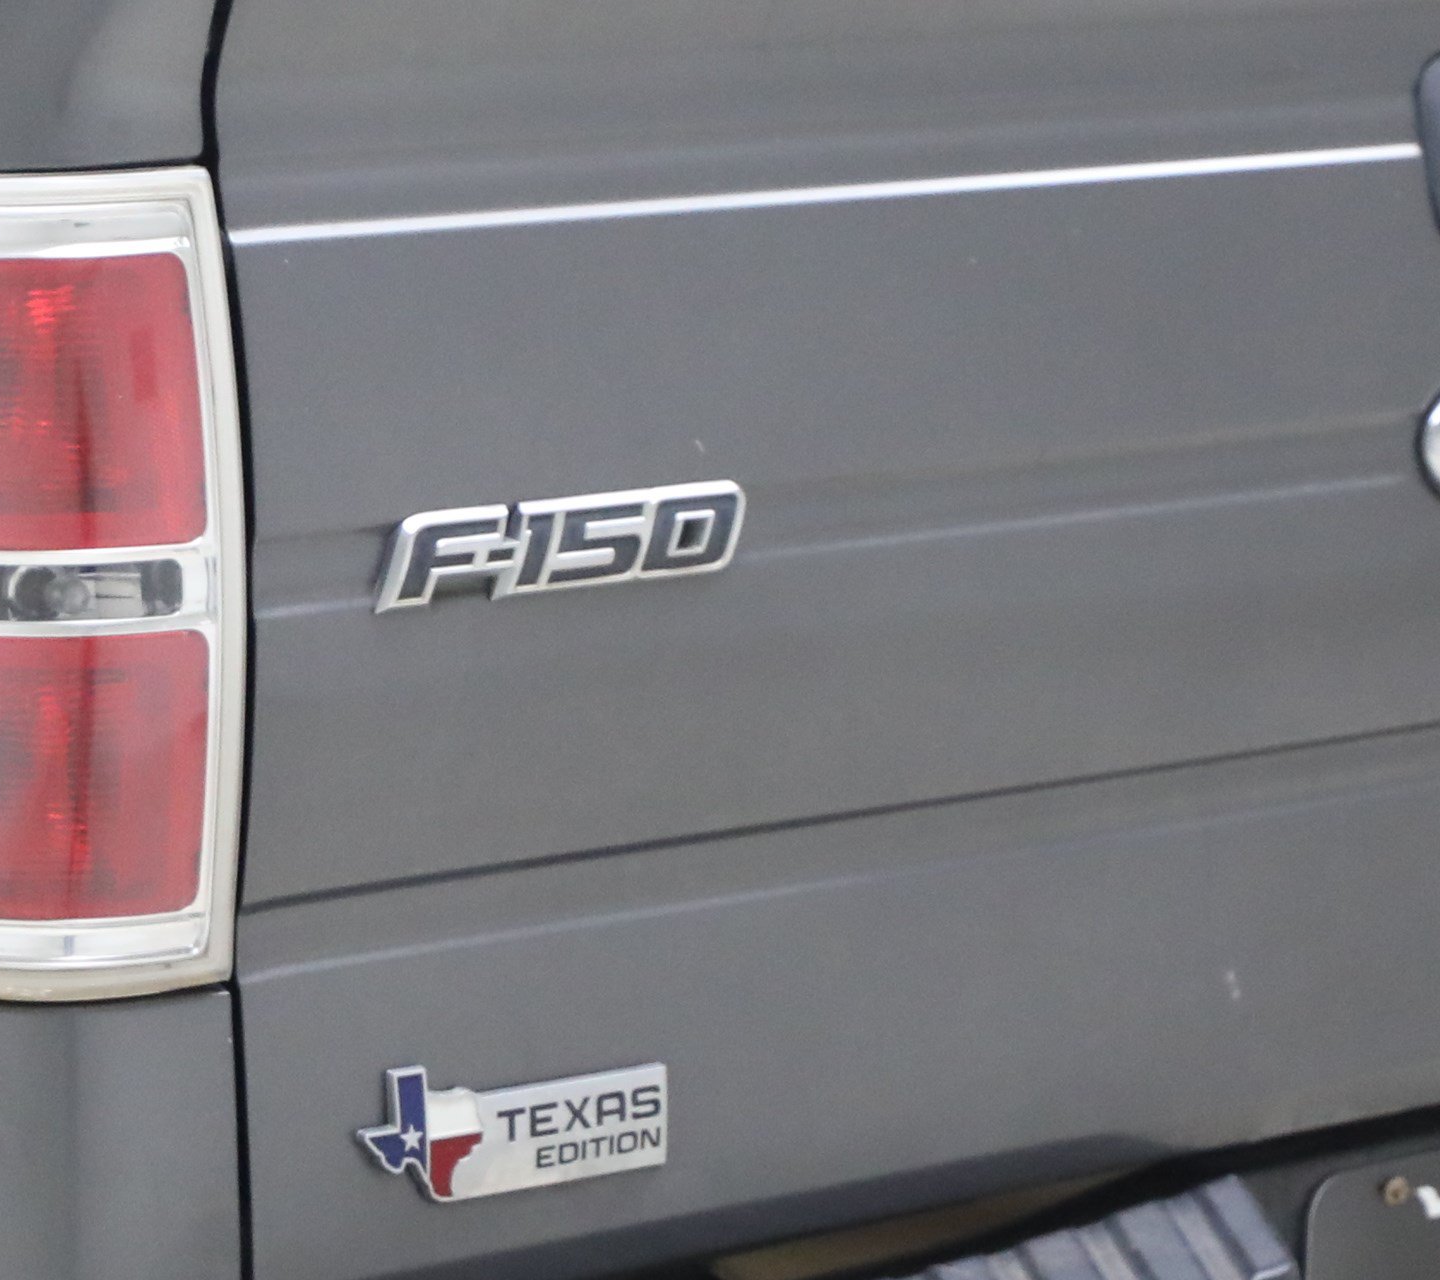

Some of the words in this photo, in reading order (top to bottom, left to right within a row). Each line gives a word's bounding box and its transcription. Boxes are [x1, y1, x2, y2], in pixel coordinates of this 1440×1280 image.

[374, 480, 745, 613] F-150
[496, 1084, 661, 1142] TEXAS
[535, 1127, 661, 1169] EDITION
